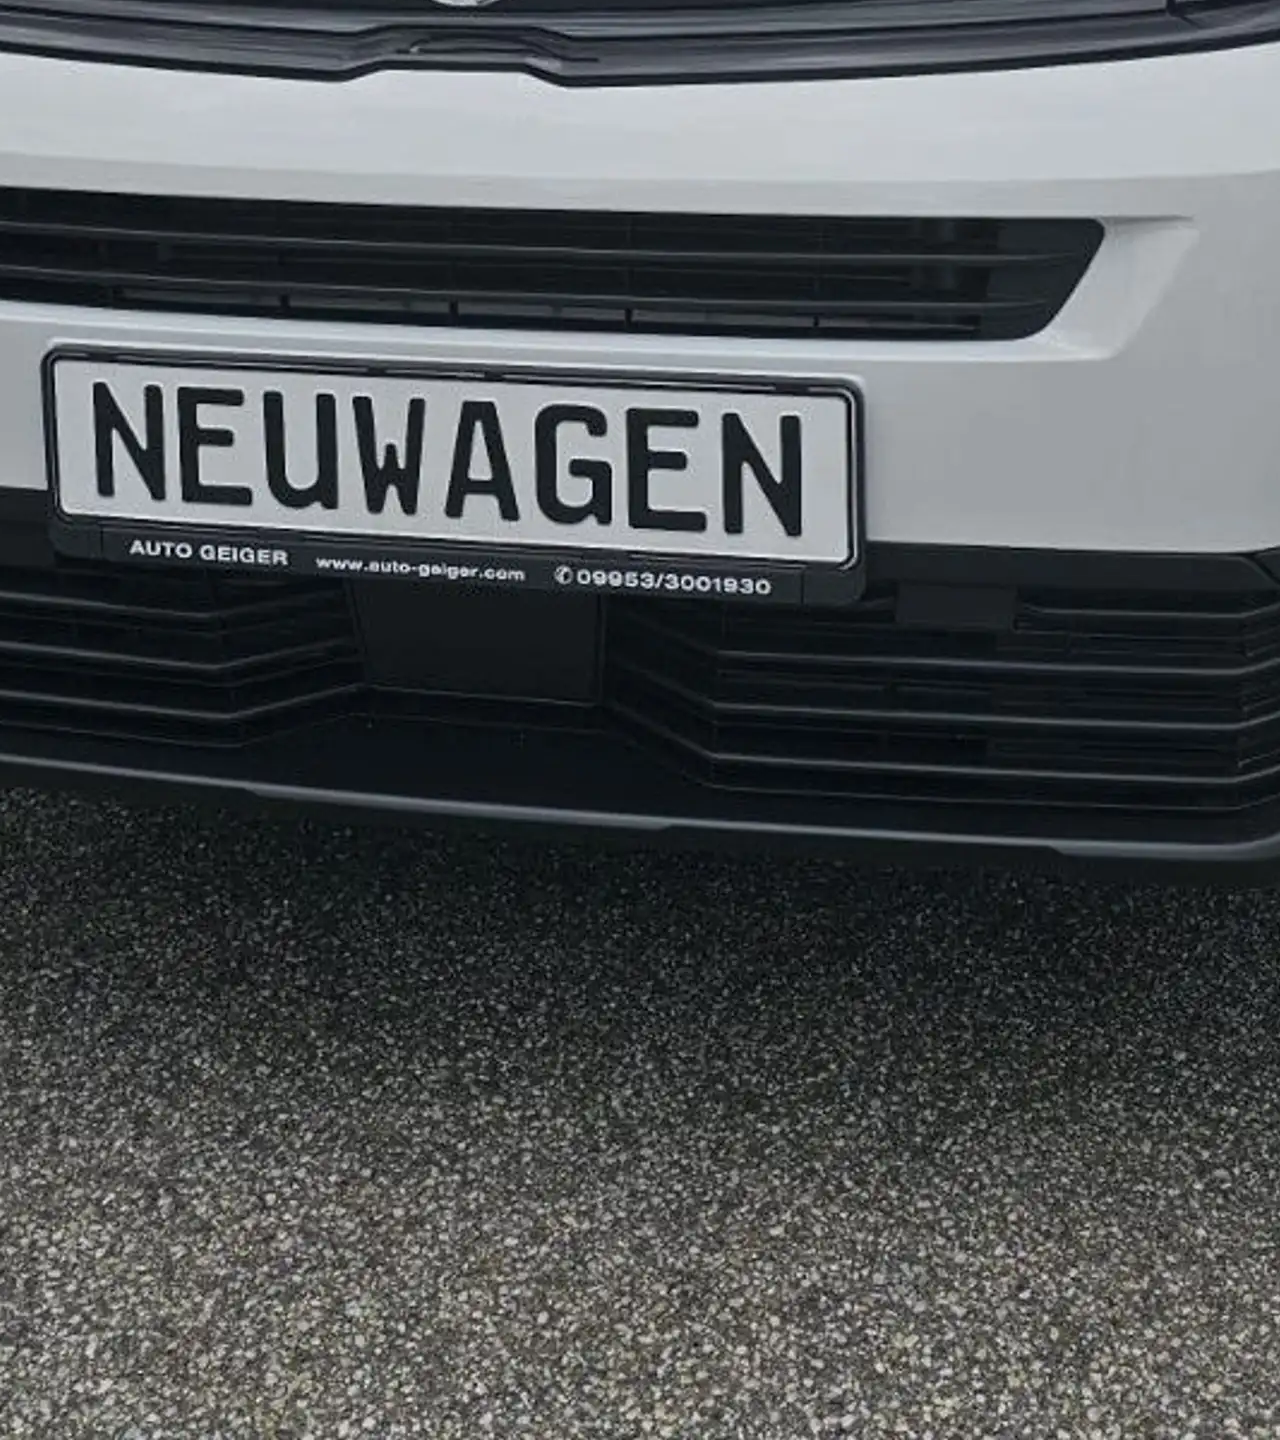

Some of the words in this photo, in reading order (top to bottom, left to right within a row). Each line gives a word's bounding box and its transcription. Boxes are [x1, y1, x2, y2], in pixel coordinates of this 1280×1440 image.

[92, 380, 803, 537] NEUWAGEN
[129, 539, 193, 559] AUTO
[199, 544, 289, 566] GEIGER
[315, 557, 526, 581] www.auto-geiger.com
[576, 568, 772, 595] 09953/3001930
